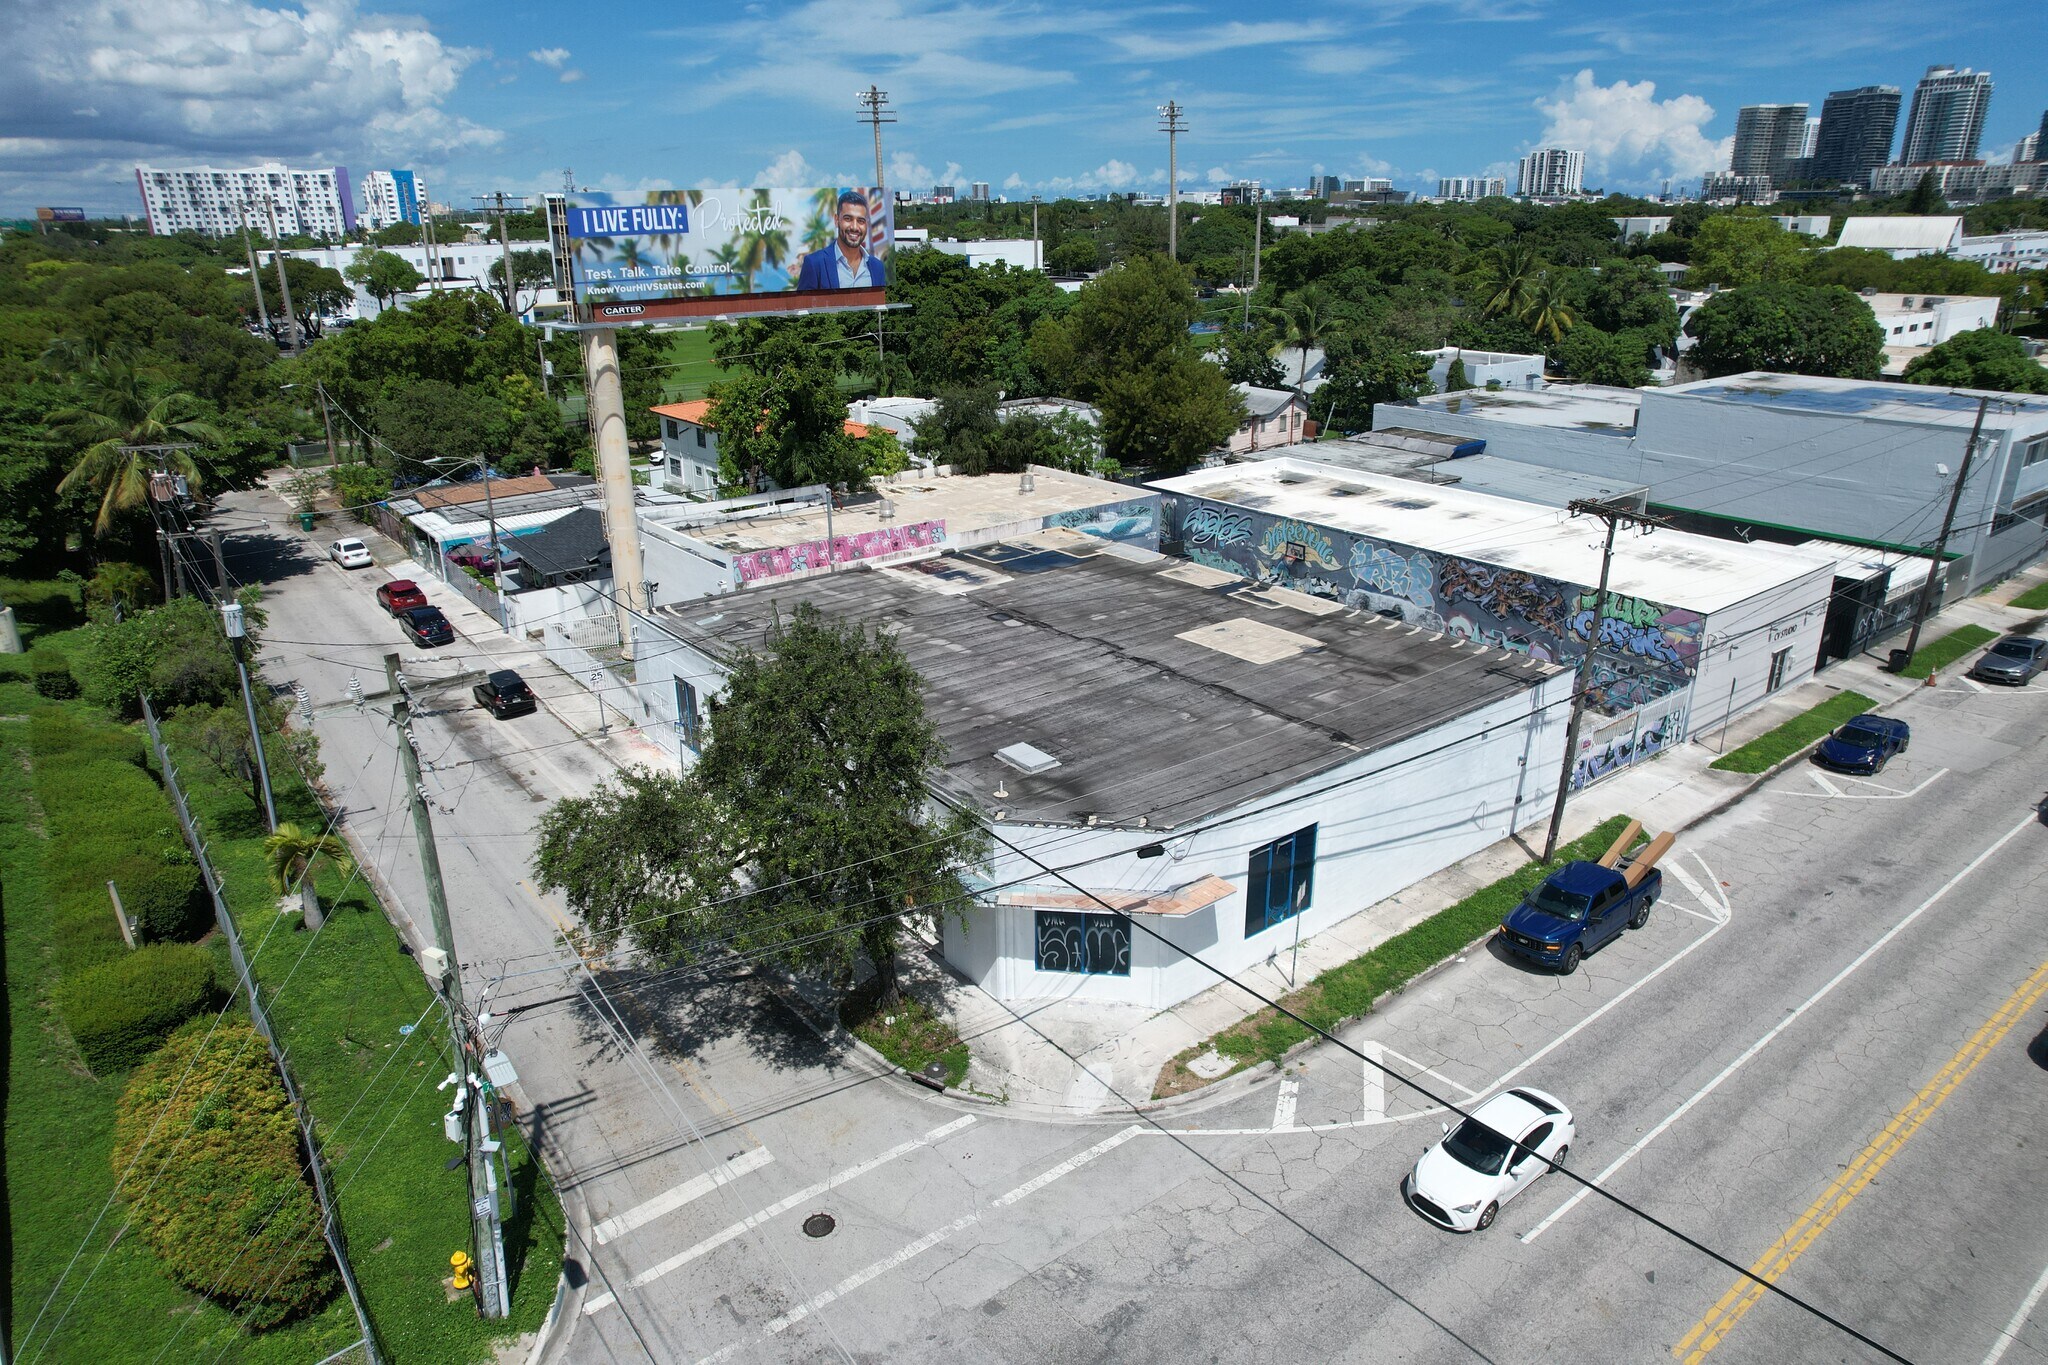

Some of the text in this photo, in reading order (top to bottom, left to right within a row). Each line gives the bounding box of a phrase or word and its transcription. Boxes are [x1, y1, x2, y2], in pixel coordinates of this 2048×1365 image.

[582, 207, 683, 233] I LIVE FULLY:
[692, 197, 784, 240] Protected
[585, 262, 734, 280] Test. Talk. Take Control.
[586, 281, 705, 295] KnowYourHIVStatus.com
[605, 306, 642, 315] CARTER
[1780, 624, 1798, 639] STUDIO
[591, 671, 603, 680] 25
